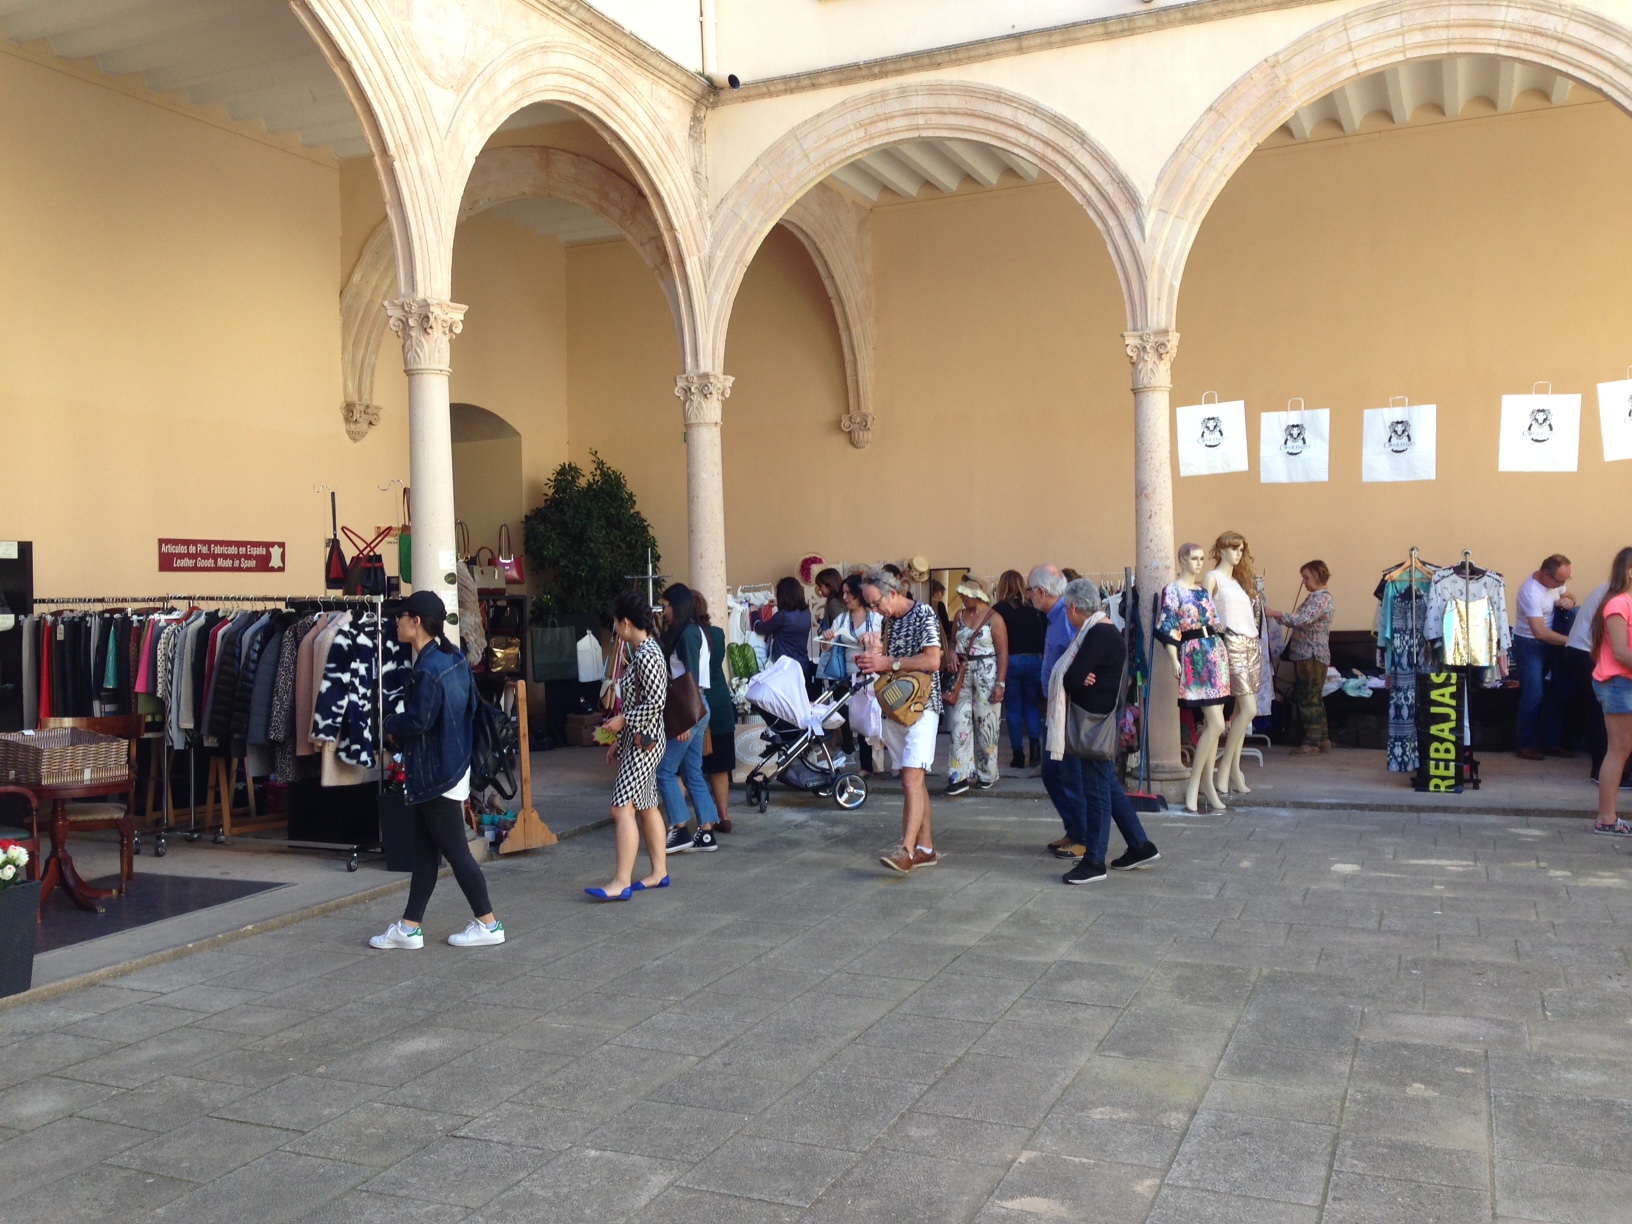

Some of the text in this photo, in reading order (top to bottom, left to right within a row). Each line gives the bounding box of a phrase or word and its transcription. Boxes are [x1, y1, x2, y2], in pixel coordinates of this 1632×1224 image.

[189, 544, 196, 554] de
[197, 544, 210, 554] Piel.
[210, 544, 238, 555] Fabricado
[239, 546, 246, 555] en
[247, 545, 266, 556] España
[173, 557, 257, 569] Leather Goods. Made in Spain
[1429, 672, 1458, 793] REBAJAS
